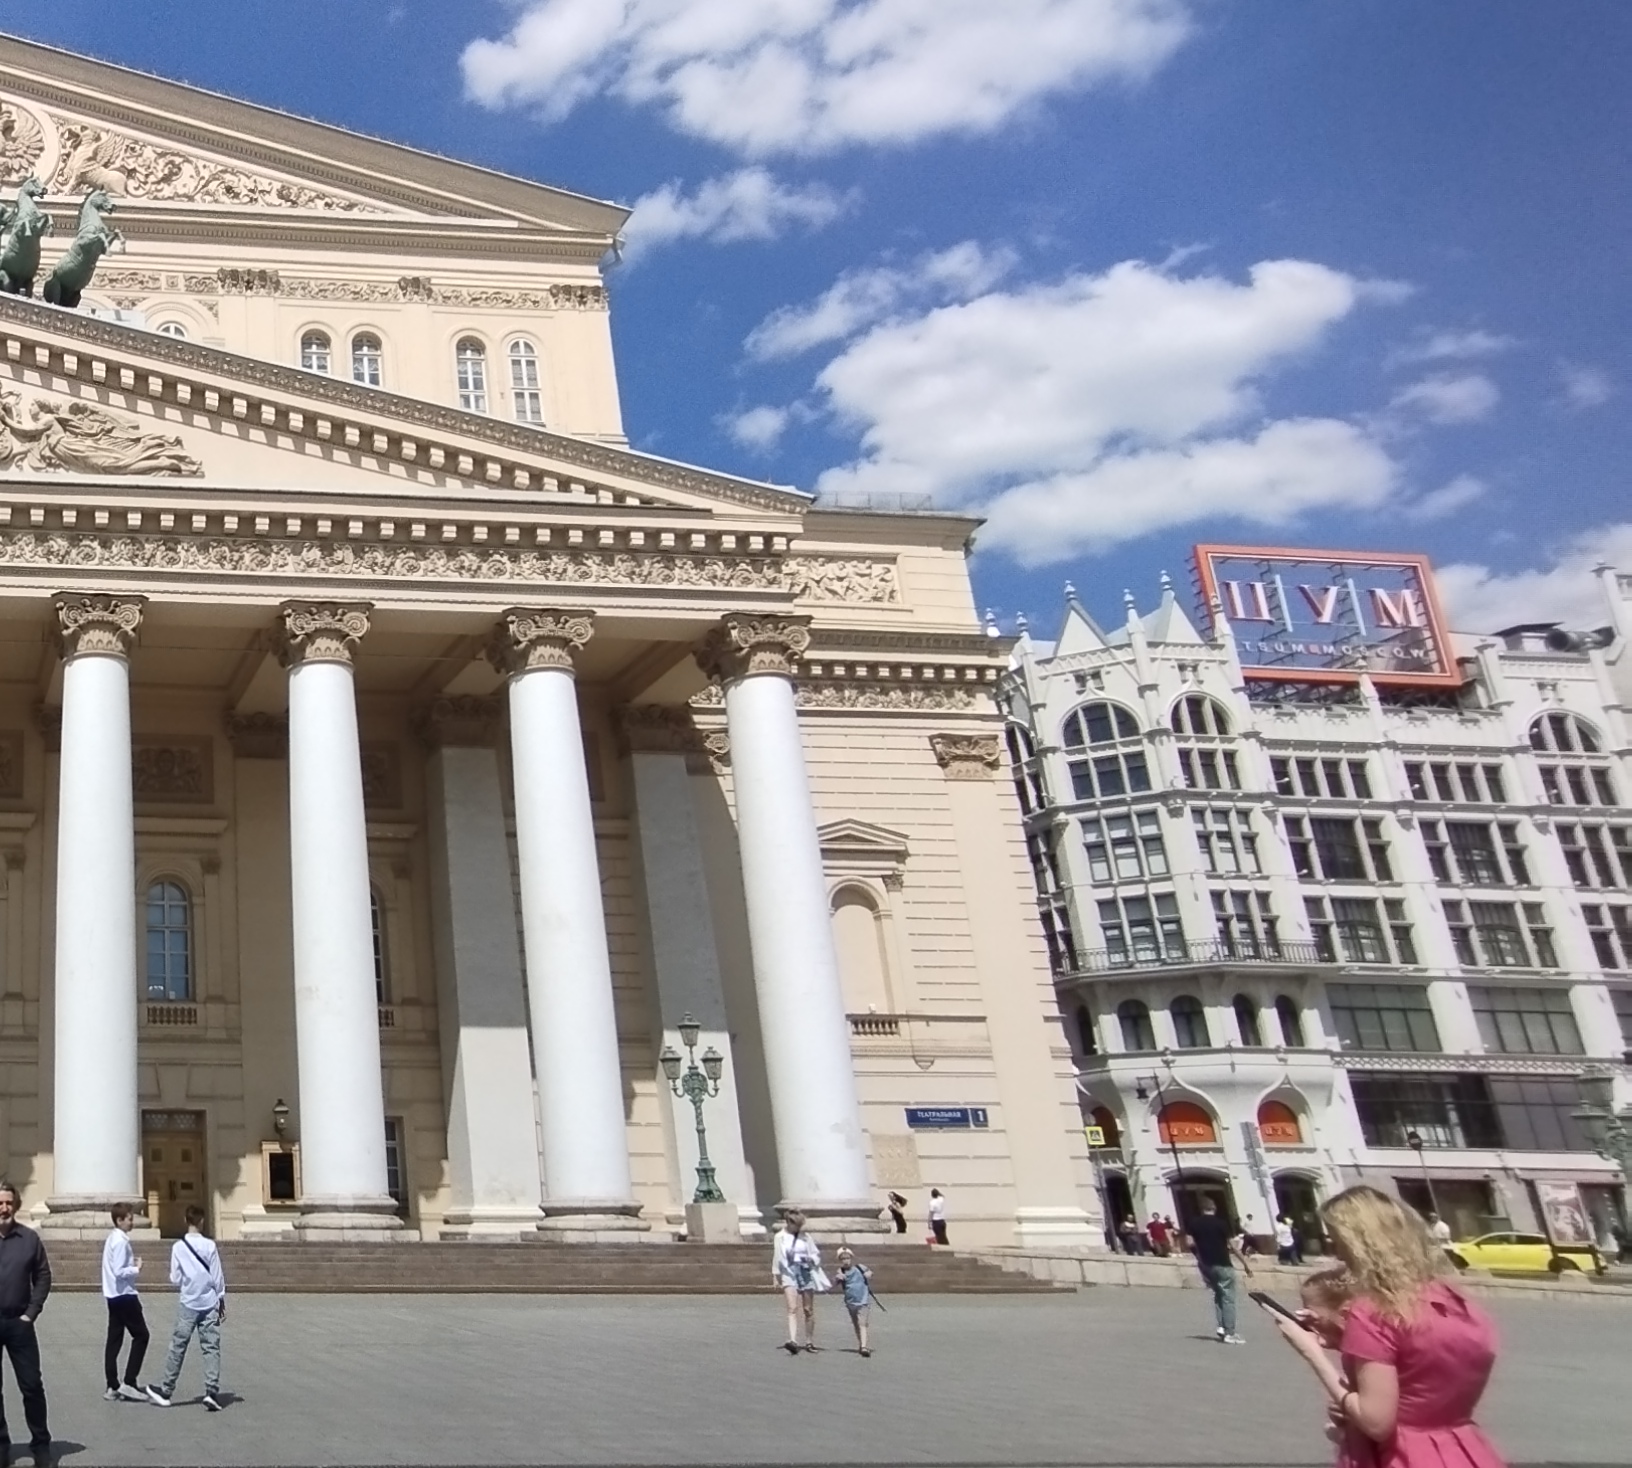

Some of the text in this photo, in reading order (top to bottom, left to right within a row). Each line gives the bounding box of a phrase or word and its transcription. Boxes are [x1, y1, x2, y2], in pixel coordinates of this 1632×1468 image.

[1241, 640, 1425, 660] TSUM MOSCOW
[977, 1110, 984, 1121] 1
